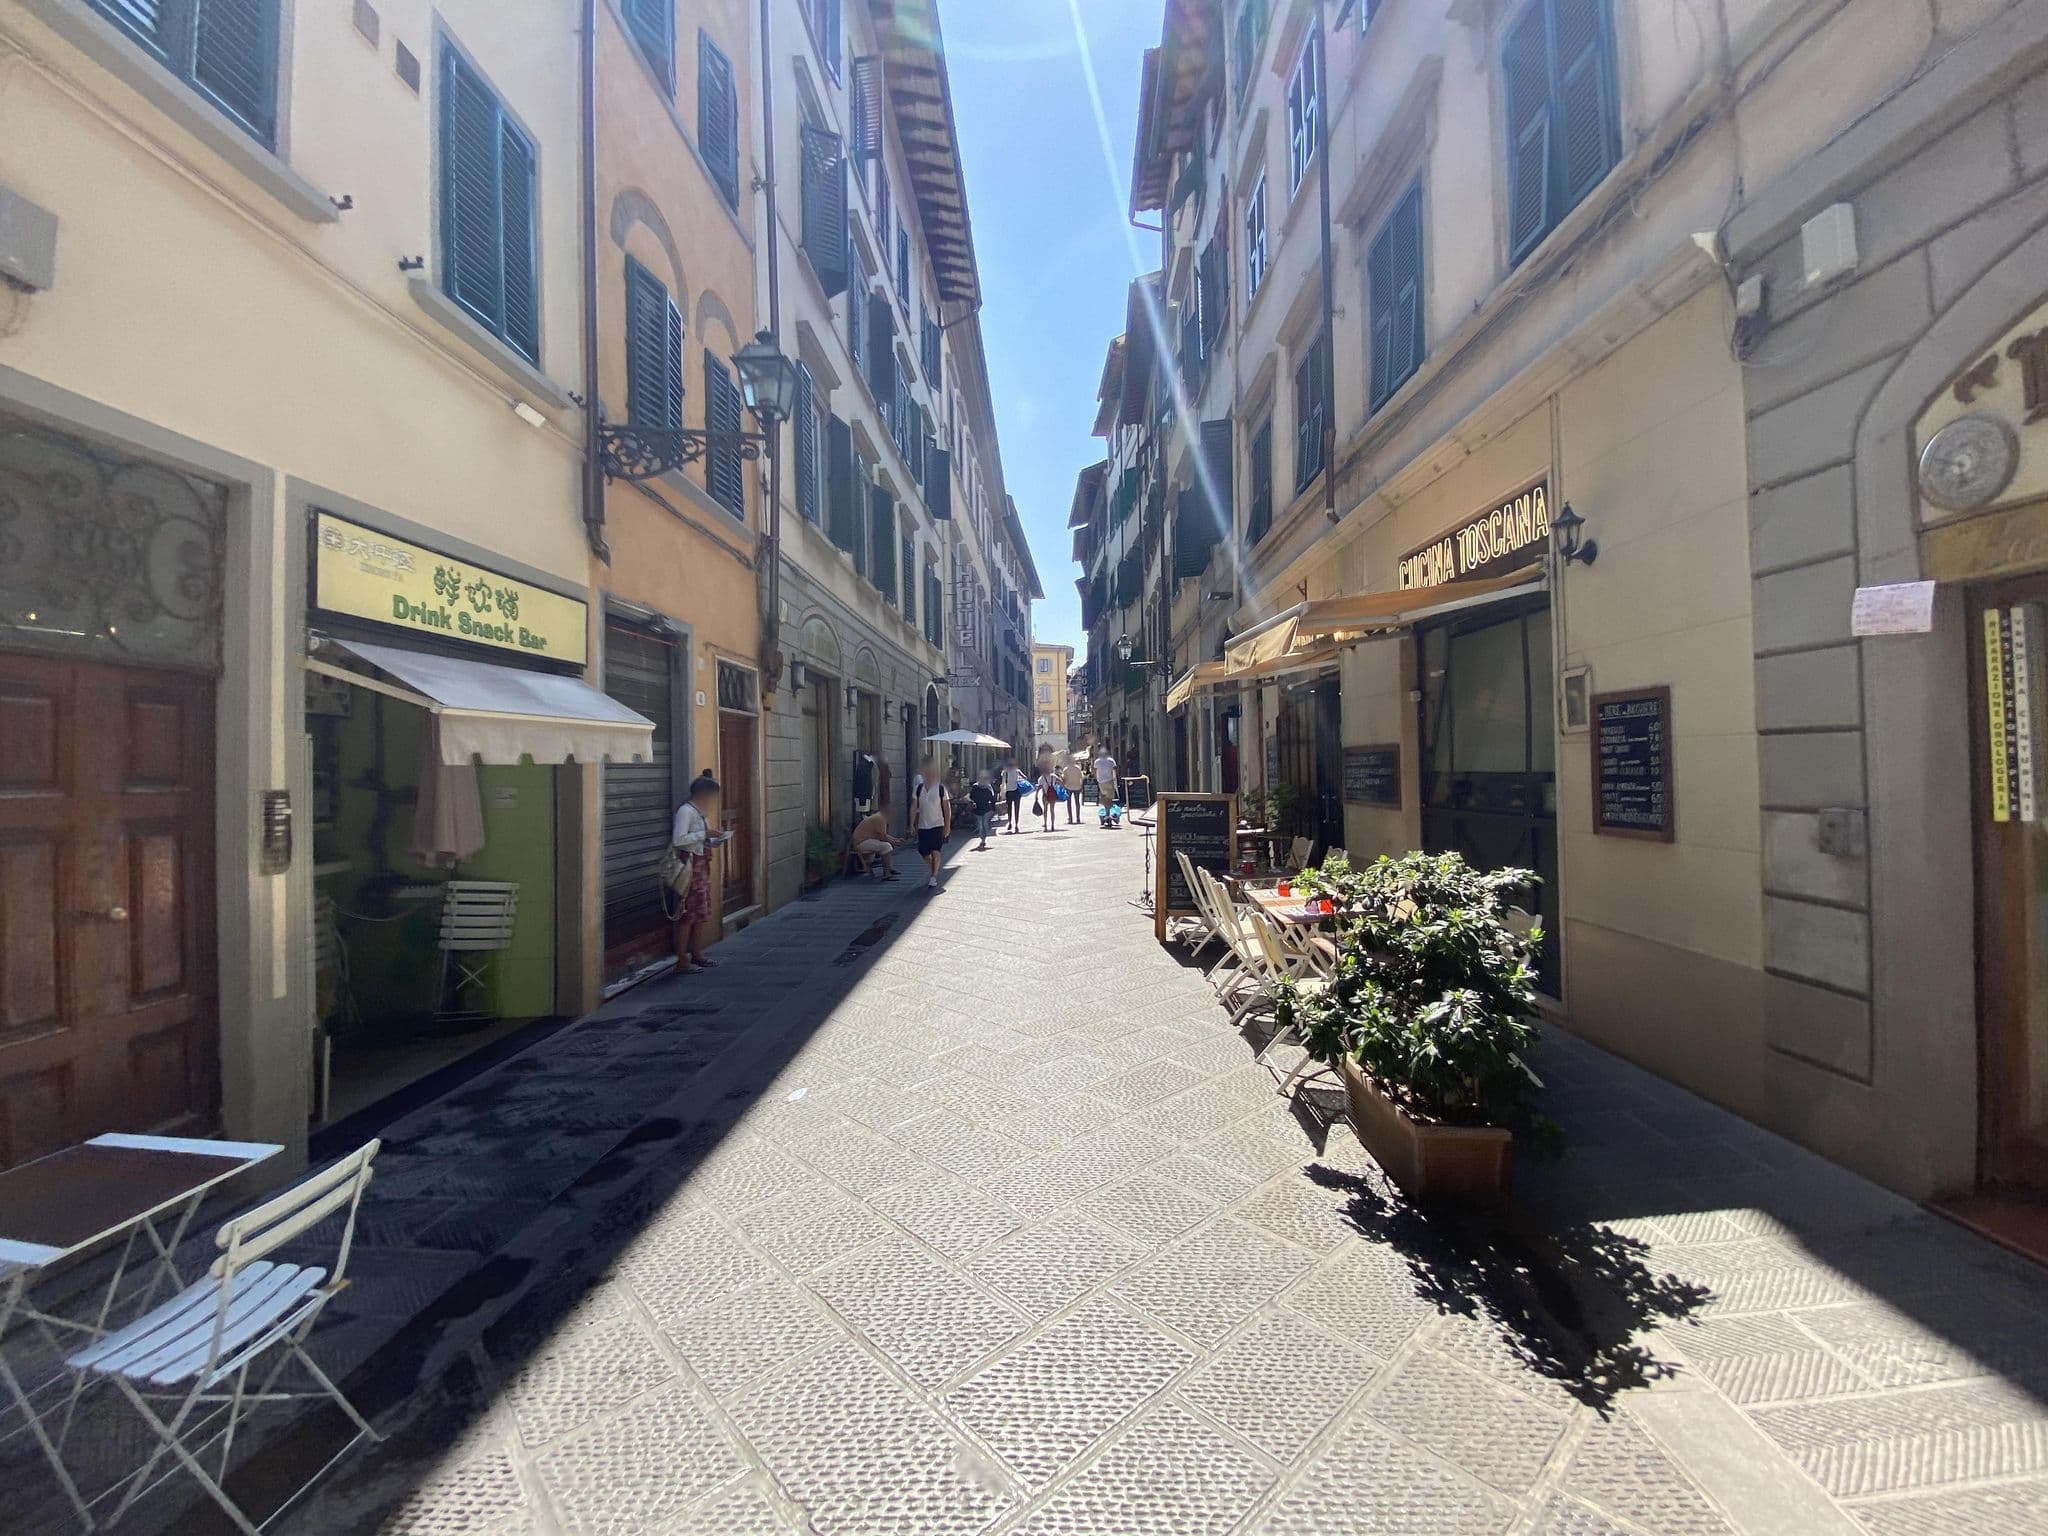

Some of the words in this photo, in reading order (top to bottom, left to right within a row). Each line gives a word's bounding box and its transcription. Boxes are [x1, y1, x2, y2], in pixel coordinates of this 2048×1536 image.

[1399, 537, 1455, 590] CUCINA
[1456, 487, 1549, 573] TOSCANA
[392, 595, 453, 630] Drink
[457, 611, 515, 644] Snack
[518, 626, 548, 651] Bar
[957, 560, 975, 670] HOTEL
[2014, 617, 2026, 695] VENDITA
[1989, 621, 2001, 718] RIPARAZIONE
[1993, 722, 2005, 811] OROLOGERIA
